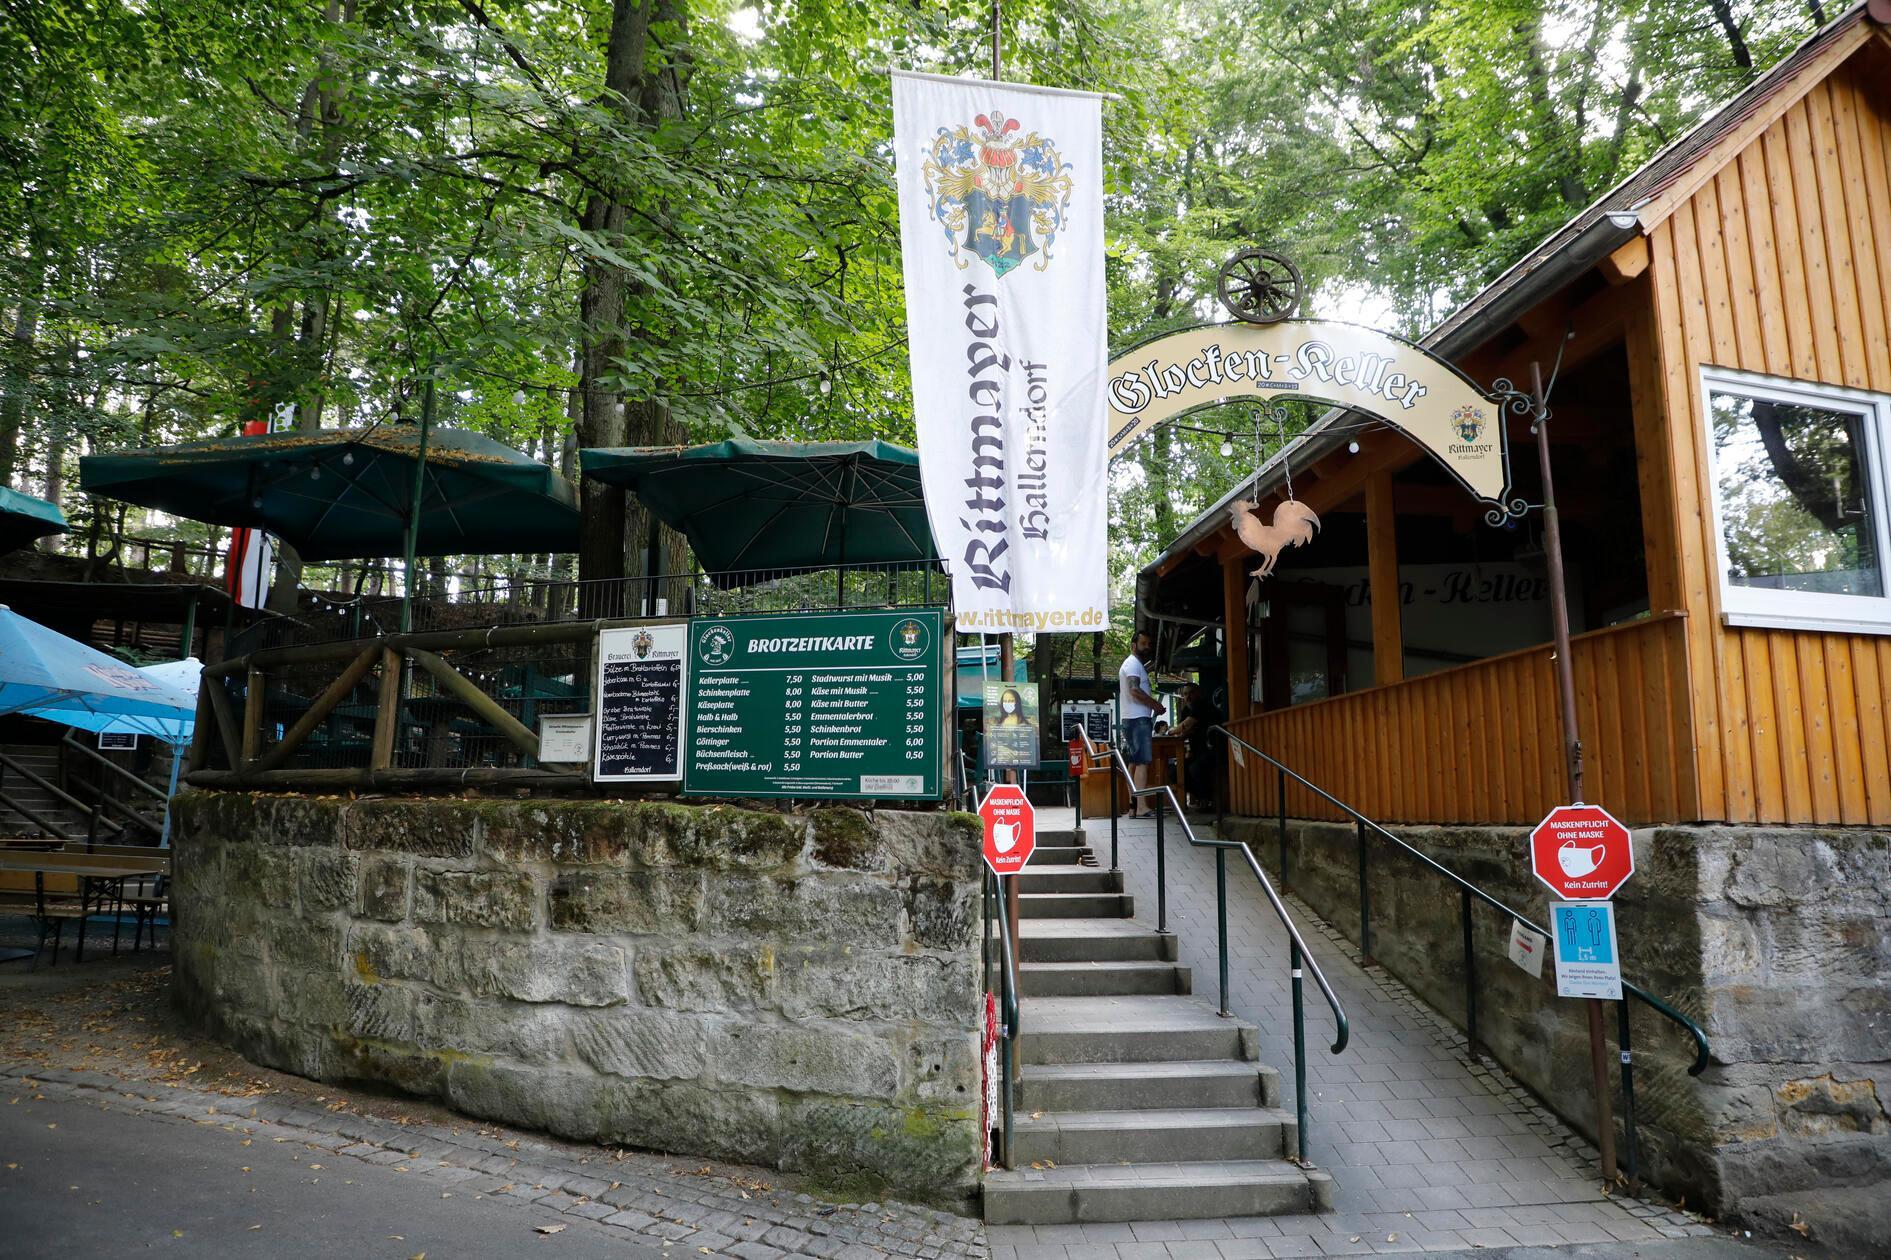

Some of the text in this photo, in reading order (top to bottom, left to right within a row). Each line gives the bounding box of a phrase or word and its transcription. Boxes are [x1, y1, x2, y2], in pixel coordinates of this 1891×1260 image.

[959, 282, 1012, 596] Rittmayer
[1448, 444, 1493, 454] Rittmayer
[747, 635, 875, 653] BROTZEITKARTE
[698, 675, 803, 686] Kellerplatte 7,50
[811, 672, 925, 683] Stadtwurst mit Musik 5,00
[698, 688, 803, 698] Schinkenplatte 8,00
[811, 686, 925, 696] Käse mit Musik 5,50
[697, 700, 802, 710] Käseplatte 8,00
[811, 698, 924, 708] Käse mit Butter 5,50
[697, 712, 802, 722] Halb & Halb 5,50
[810, 712, 924, 721] Emmentalerbrot 5,50
[696, 725, 802, 734] Bierschinken 5,50
[810, 724, 924, 734] Schinkenbrot 5,50
[696, 738, 801, 747] Göttinger 5,50
[810, 738, 924, 748] Portion Emmentaler 6,00
[696, 750, 801, 760] Büchsenfleisch 5,50
[810, 750, 924, 760] Portion Butter 0,50
[750, 763, 757, 771] &
[757, 762, 772, 772] rot)
[784, 763, 801, 773] 5,50
[1550, 820, 1609, 829] MASKENPFLICHT
[1557, 830, 1604, 840] OHNE MASKE
[1582, 880, 1608, 888] Zutritt!
